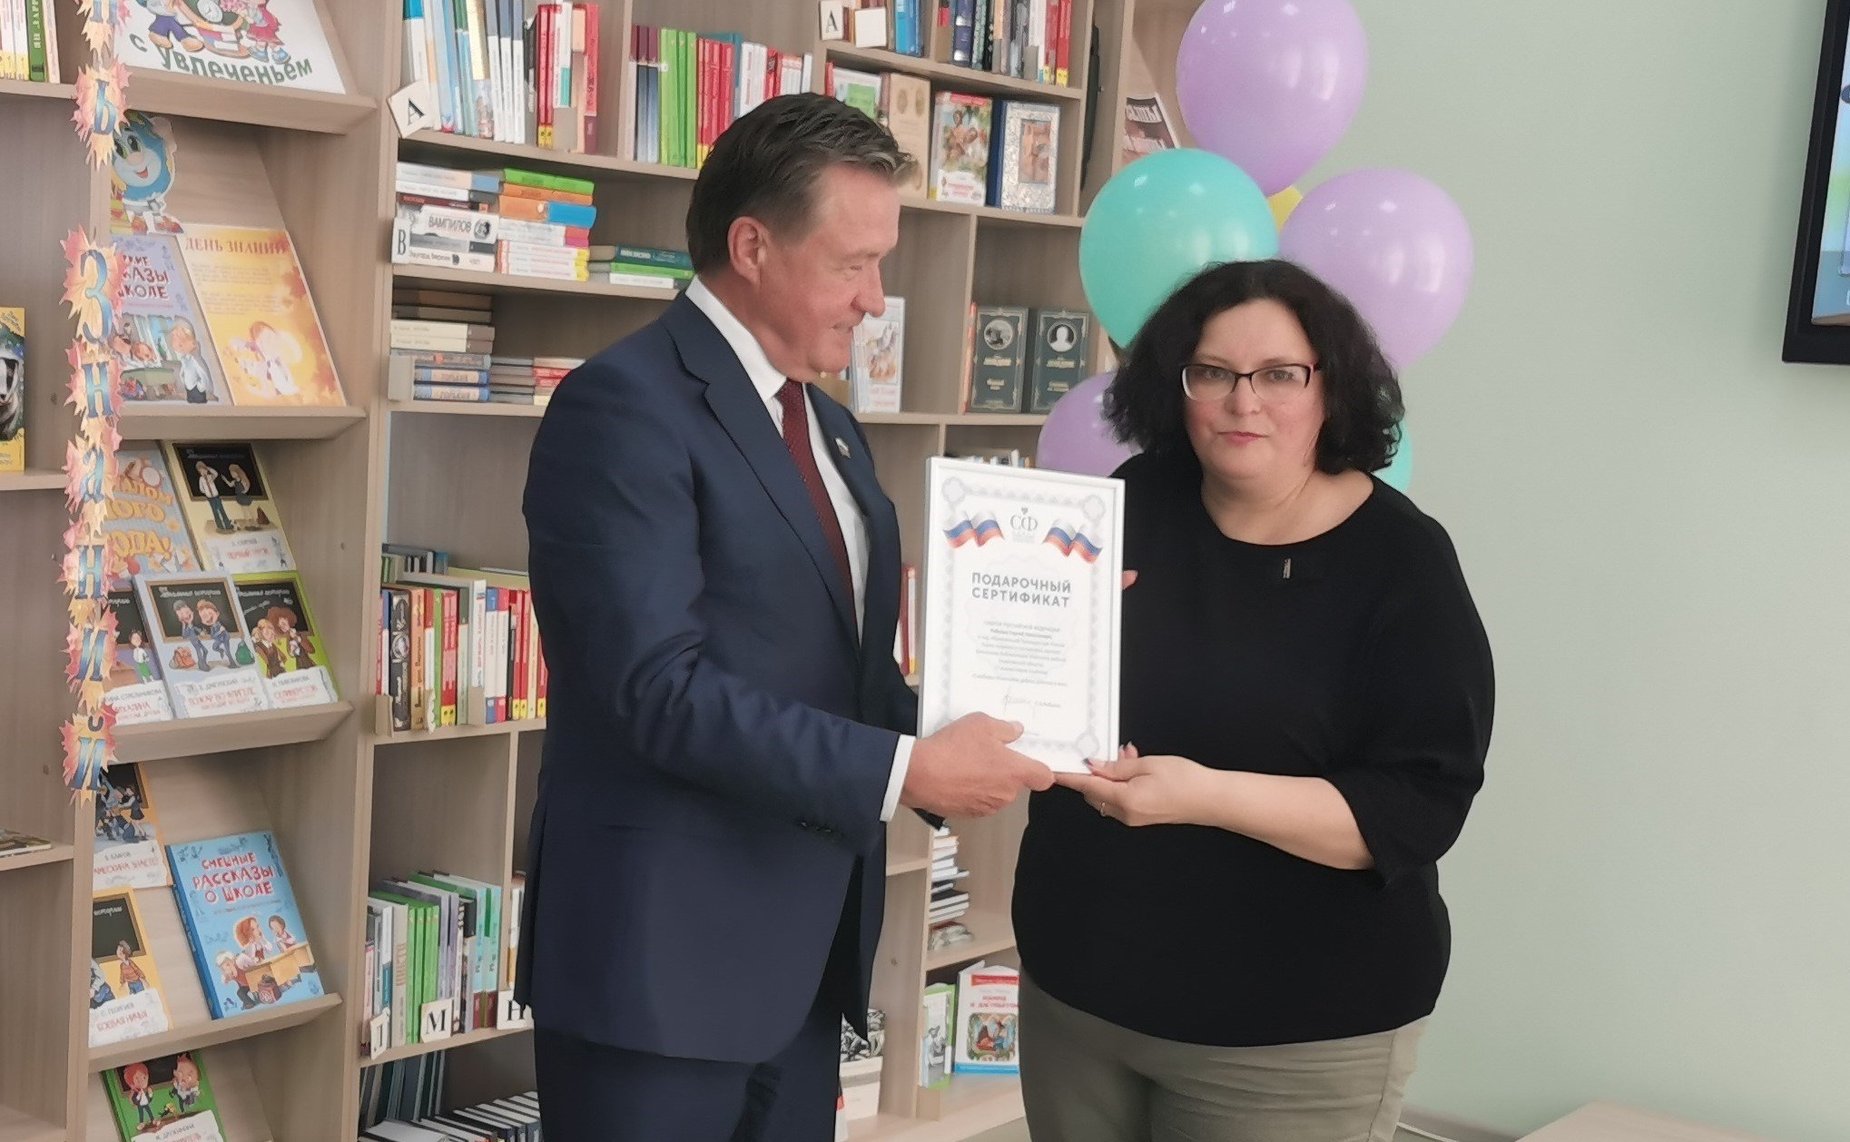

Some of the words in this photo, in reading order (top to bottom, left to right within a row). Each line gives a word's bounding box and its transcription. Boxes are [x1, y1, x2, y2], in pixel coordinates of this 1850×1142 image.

[826, 9, 838, 33] А
[407, 97, 425, 126] А
[428, 216, 472, 233] ВАМПИЛОВ
[397, 229, 407, 255] В
[1010, 514, 1038, 532] СФ
[972, 572, 1071, 594] ПОДАРОЧНЫЙ
[972, 587, 1070, 608] СЕРТИФИКАТ
[201, 852, 255, 869] СМЕШНЫЕ
[192, 866, 274, 890] РАССКАЗЫ
[205, 890, 217, 903] О
[222, 881, 272, 902] ШКОЛЕ
[427, 1009, 446, 1034] М
